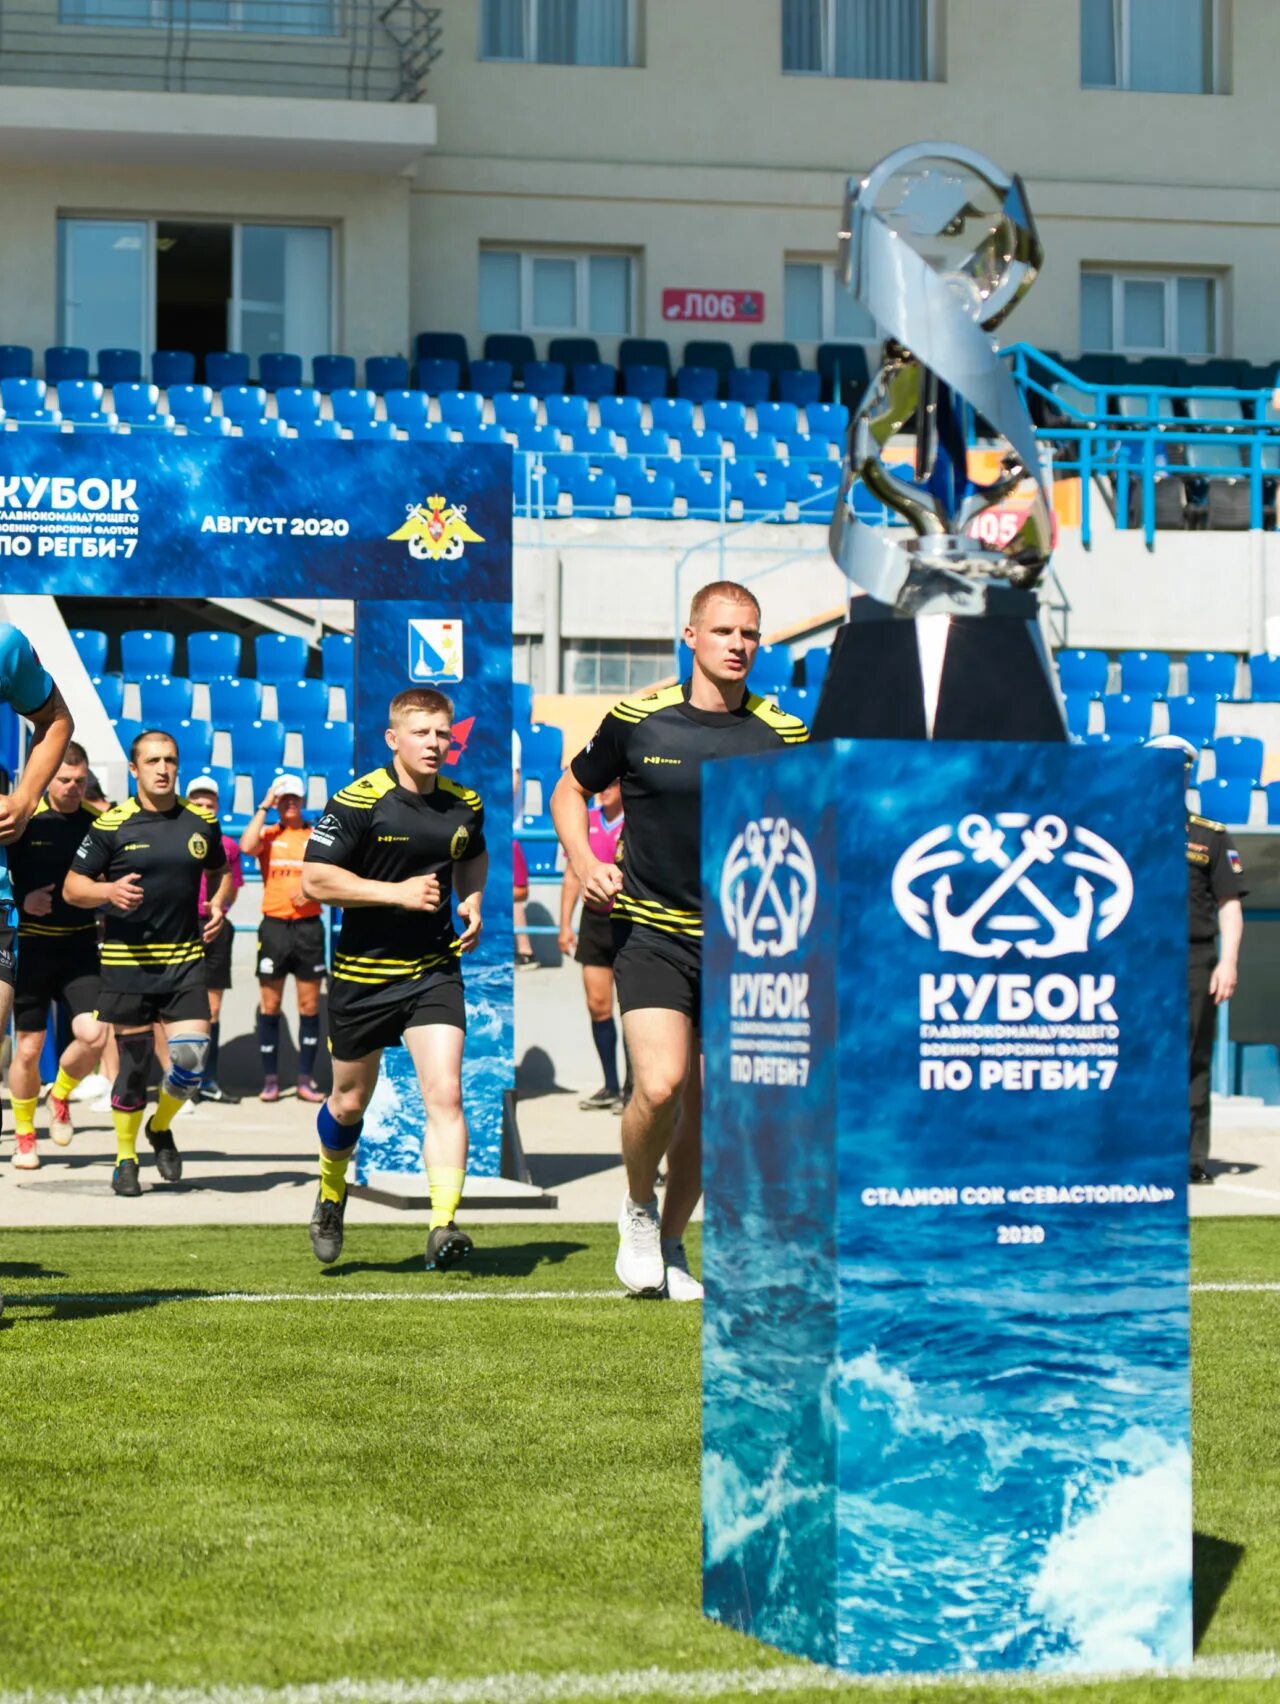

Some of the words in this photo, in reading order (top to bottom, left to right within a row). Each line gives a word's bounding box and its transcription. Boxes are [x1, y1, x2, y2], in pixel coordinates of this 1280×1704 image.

[201, 515, 287, 534] АВГУСТ
[290, 518, 349, 537] 2020
[37, 537, 138, 558] РЕГБИ-7
[730, 973, 810, 1019] КУБОК
[919, 973, 1118, 1021] КУБОК
[920, 1023, 1120, 1039] ГЛАВНОКОМАНДУЮЩЕГО
[730, 1055, 752, 1083] ПО
[753, 1056, 810, 1087] РЕГБИ-7
[920, 1060, 972, 1090] ПО
[980, 1060, 1118, 1090] РЕГБИ-7
[861, 1187, 958, 1207] СТАДИОН
[960, 1186, 1006, 1205] СОК
[1007, 1184, 1175, 1204] «СЕВАСТОПОЛЬ»
[996, 1225, 1046, 1244] 2020
